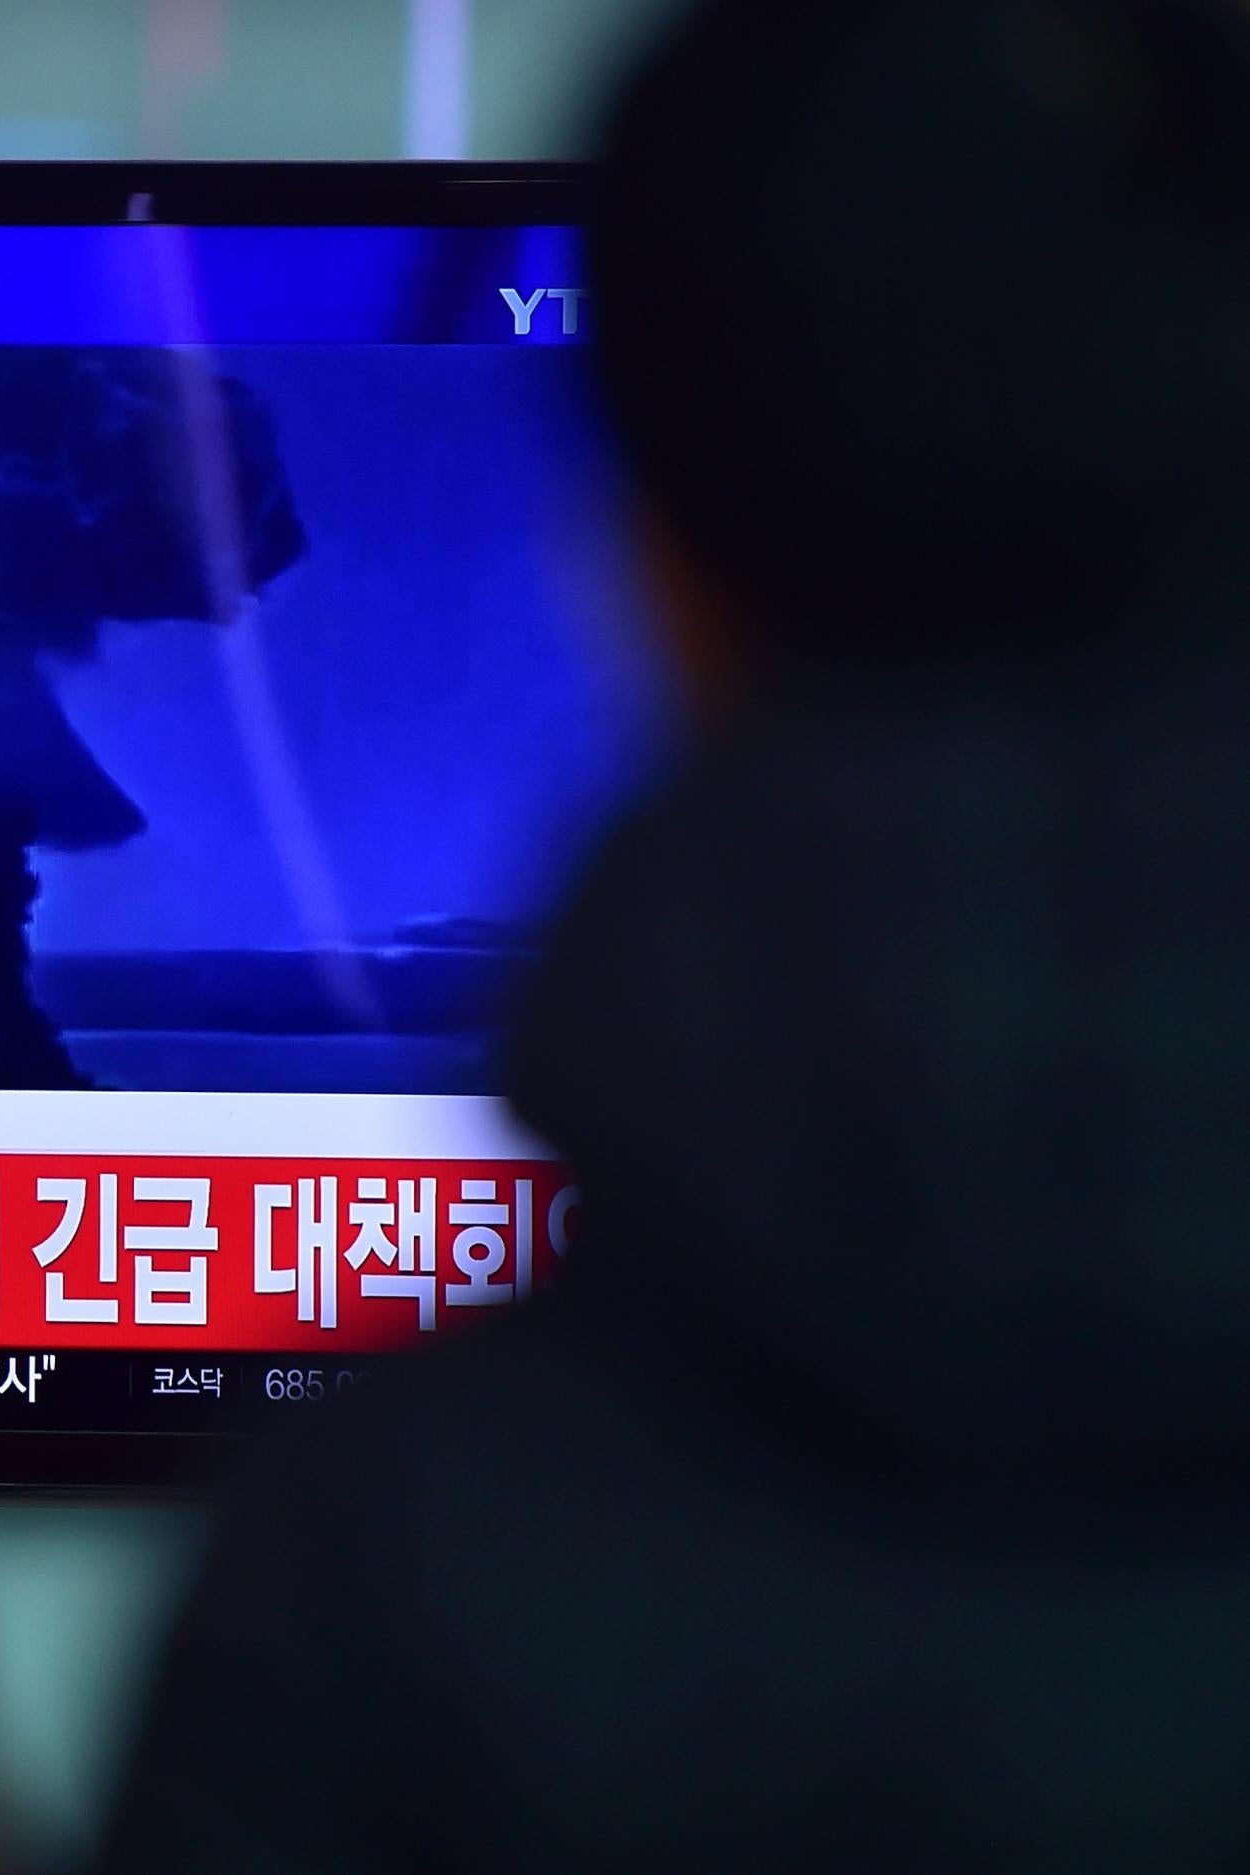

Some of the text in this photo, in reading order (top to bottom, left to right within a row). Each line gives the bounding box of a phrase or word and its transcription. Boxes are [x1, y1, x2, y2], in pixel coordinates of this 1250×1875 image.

[31, 1173, 219, 1326] 긴급
[253, 1175, 584, 1332] 대책회
[151, 1367, 224, 1399] 코스닥
